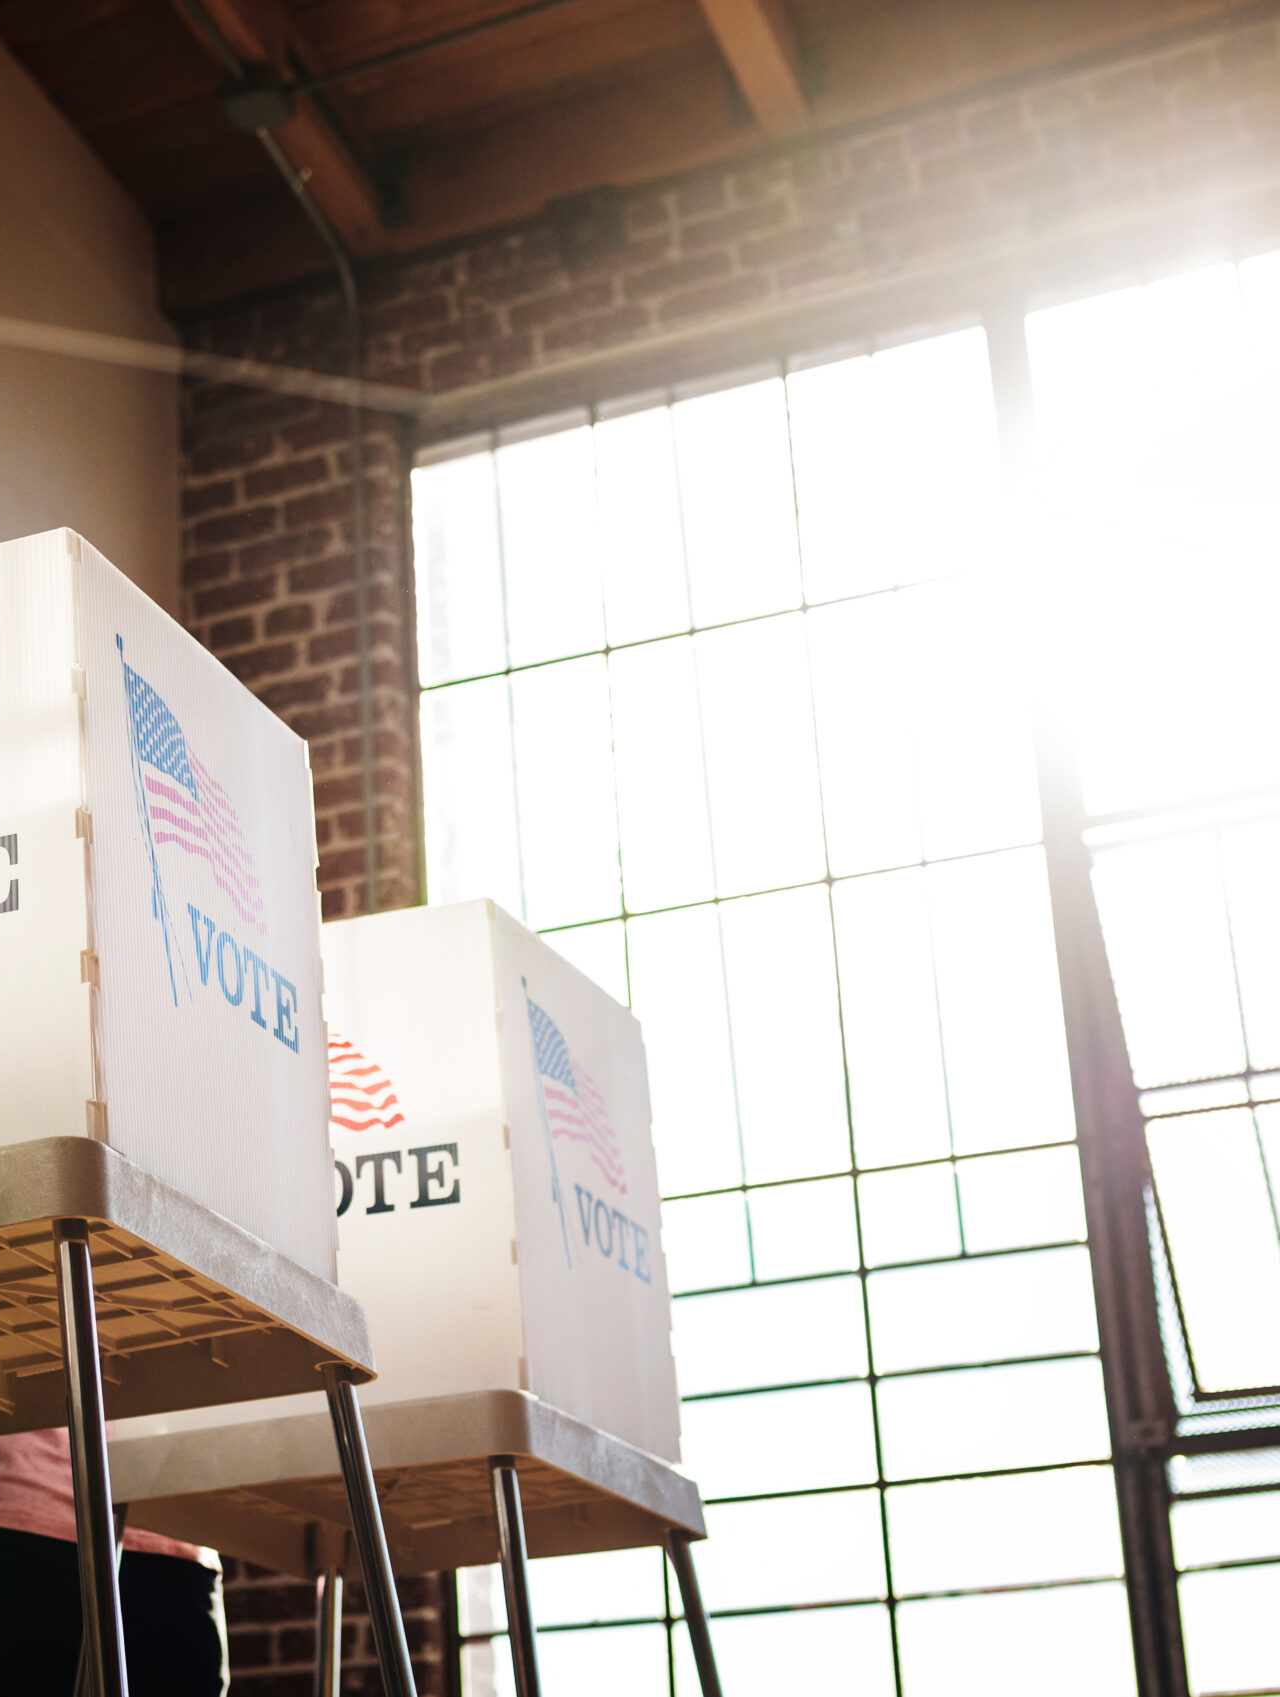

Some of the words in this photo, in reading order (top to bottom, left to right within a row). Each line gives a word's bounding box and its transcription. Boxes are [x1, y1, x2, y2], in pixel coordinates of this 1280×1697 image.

[187, 902, 300, 1055] VOTE
[334, 1142, 461, 1218] TE
[574, 1182, 652, 1285] VOTE
